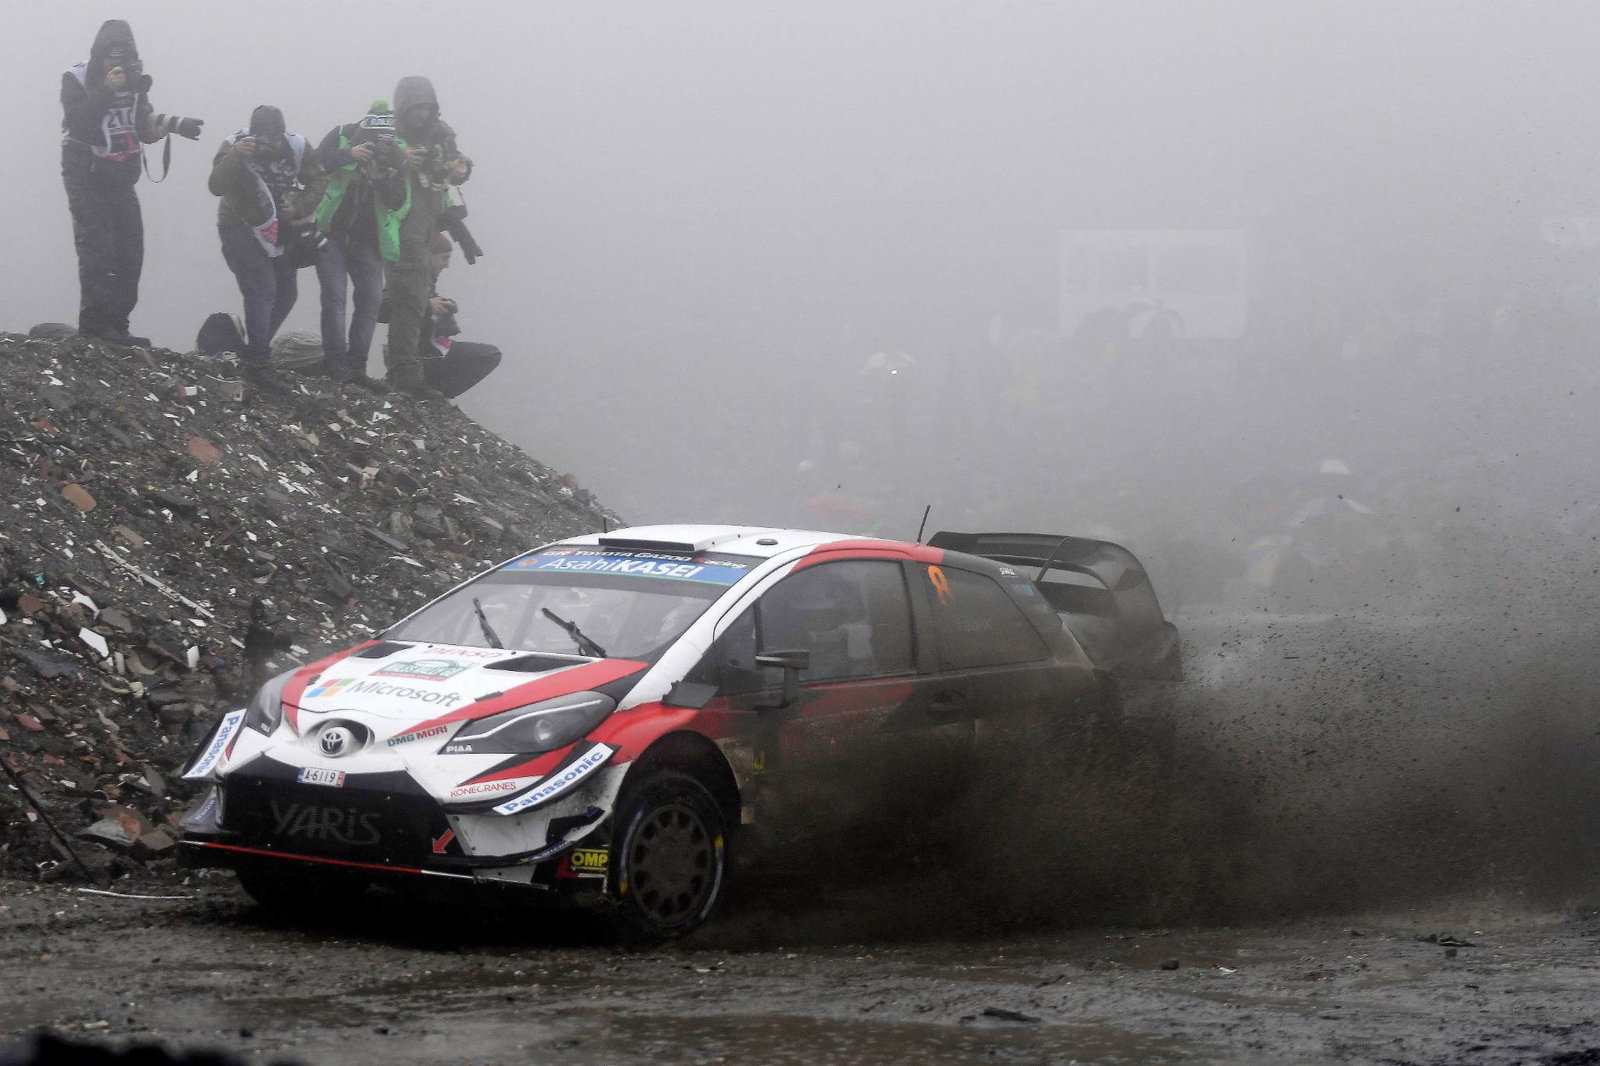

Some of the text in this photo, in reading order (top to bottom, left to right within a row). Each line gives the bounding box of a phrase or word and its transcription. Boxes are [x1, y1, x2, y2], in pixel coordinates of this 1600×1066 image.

[576, 550, 632, 558] TOYOTA
[633, 552, 692, 562] GAZOO
[539, 558, 705, 578] AsahiKASEI
[347, 679, 462, 708] Microsoft
[387, 725, 449, 747] DMG MORI
[446, 745, 473, 754] PIAA
[450, 781, 517, 798] KONECRANES
[504, 750, 605, 812] Panasonic
[571, 851, 608, 868] OMP
